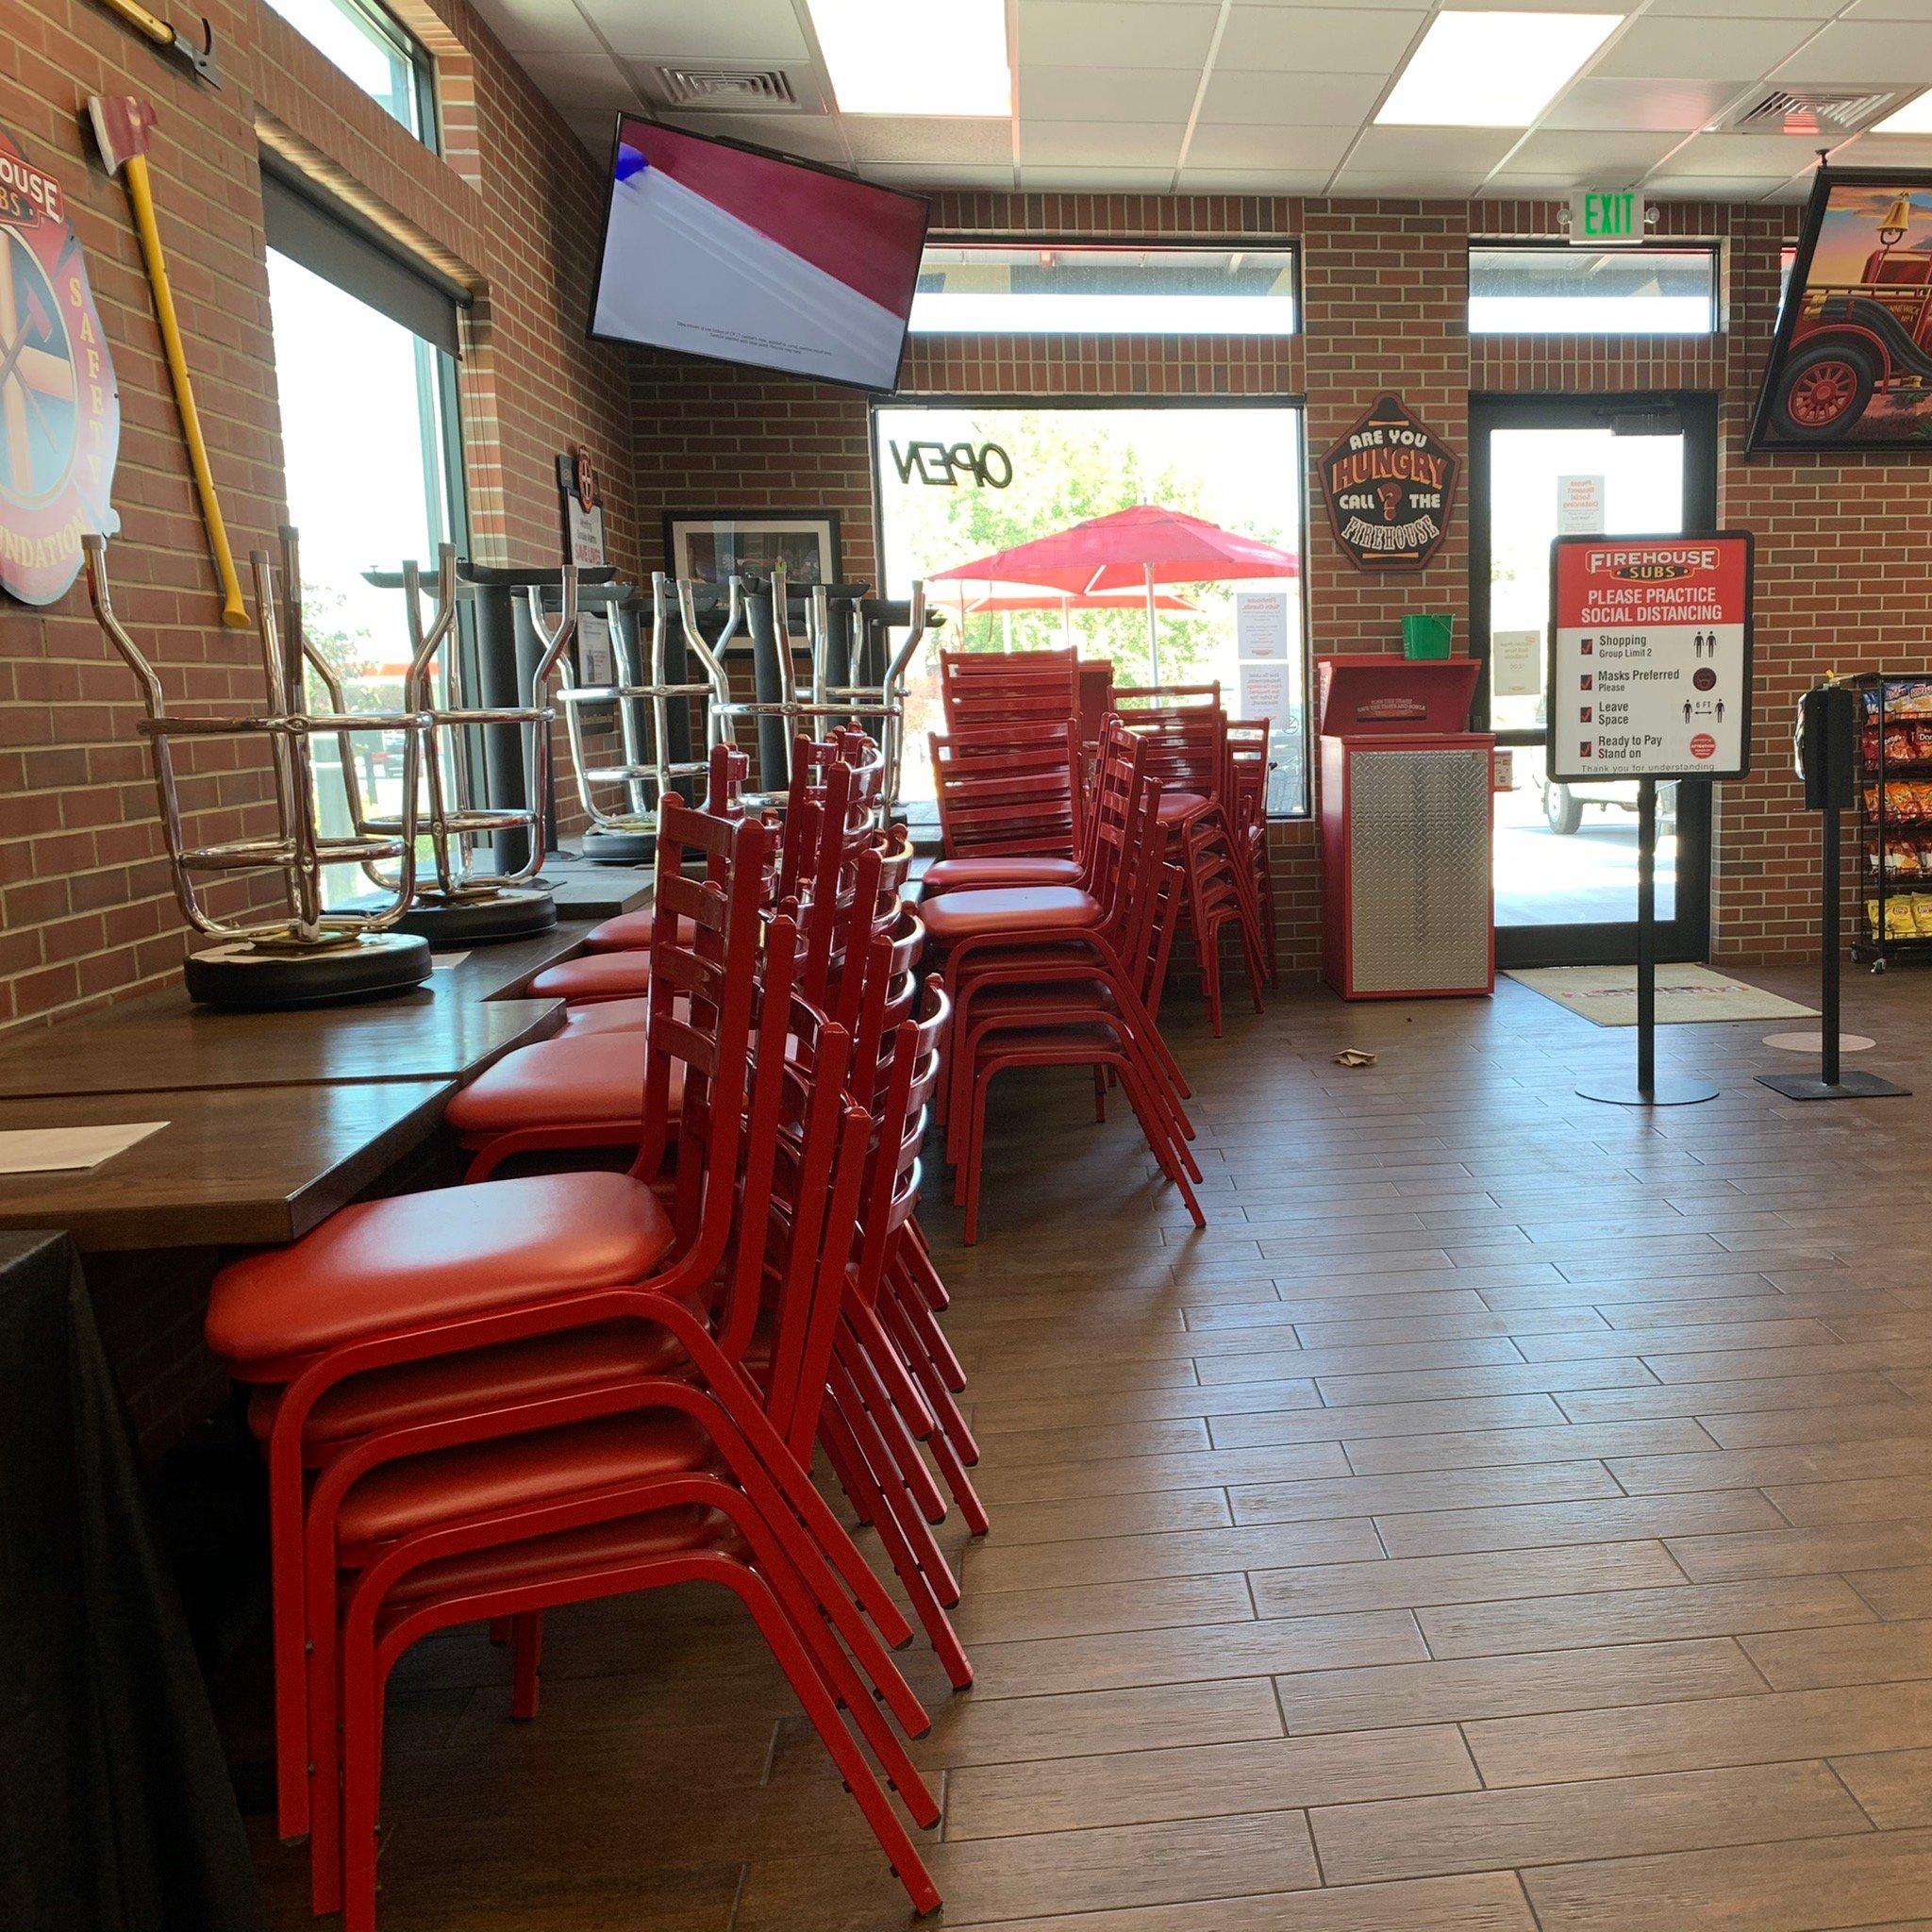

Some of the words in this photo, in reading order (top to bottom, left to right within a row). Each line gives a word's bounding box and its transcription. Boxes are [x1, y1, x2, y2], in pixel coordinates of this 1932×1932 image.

[1585, 192, 1635, 236] EXIT
[68, 275, 106, 487] SAFETY
[1349, 430, 1383, 451] ARE
[1389, 429, 1428, 448] YOU
[1332, 447, 1448, 494] HUNGRY
[1339, 494, 1374, 509] CALL
[1409, 494, 1441, 509] THE
[1341, 515, 1441, 550] FIREHOUSE
[1591, 551, 1715, 574] FIREHOUSE
[1629, 566, 1675, 578] SUBS
[1588, 589, 1642, 605] PLEASE
[1647, 587, 1716, 603] PRACTICE
[1581, 607, 1633, 623] SOCIAL
[1637, 605, 1722, 621] DISTANCING
[1600, 635, 1647, 647] Shopping
[1599, 649, 1623, 659] Group
[1598, 671, 1630, 681] Masks
[1633, 670, 1679, 681] Preferred
[1598, 683, 1625, 692] Please
[1599, 702, 1628, 712] Leave
[1598, 715, 1628, 725] Space
[1598, 736, 1630, 747] Ready
[1632, 736, 1641, 745] to
[1644, 735, 1662, 747] Pay
[1598, 749, 1626, 758] Stand
[1629, 750, 1641, 758] on
[1613, 765, 1629, 774] you
[1648, 763, 1718, 772] understanding.
